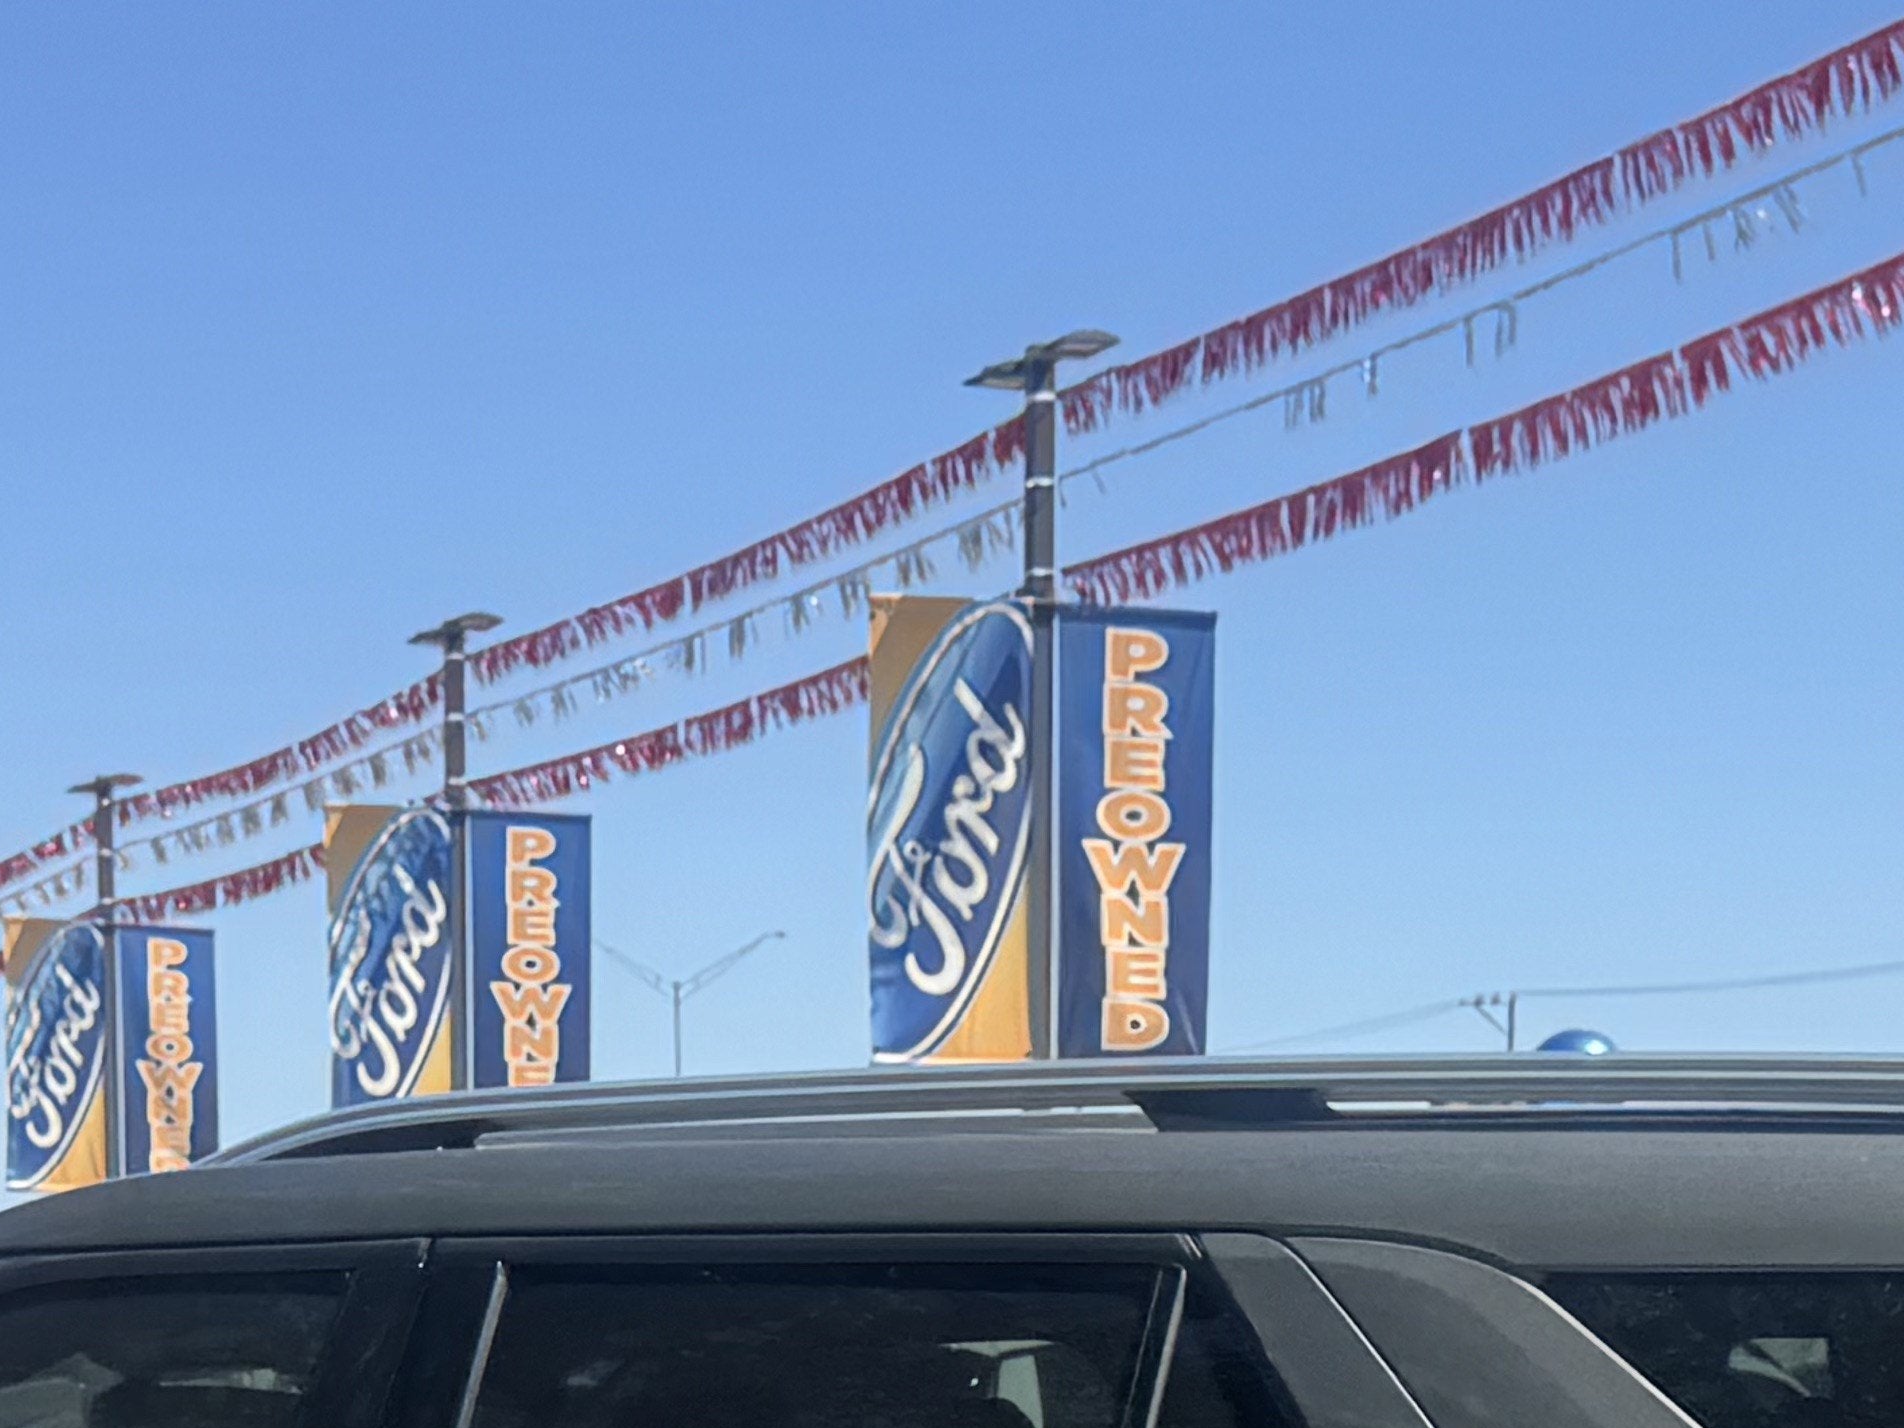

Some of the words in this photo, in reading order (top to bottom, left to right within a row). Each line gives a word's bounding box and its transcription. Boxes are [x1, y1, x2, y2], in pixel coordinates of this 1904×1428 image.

[490, 826, 572, 1088] PREOWNE
[869, 678, 1027, 996] Ford
[1081, 627, 1186, 1051] PREOWNED
[8, 963, 101, 1149] Ford
[330, 863, 447, 1098] Ford
